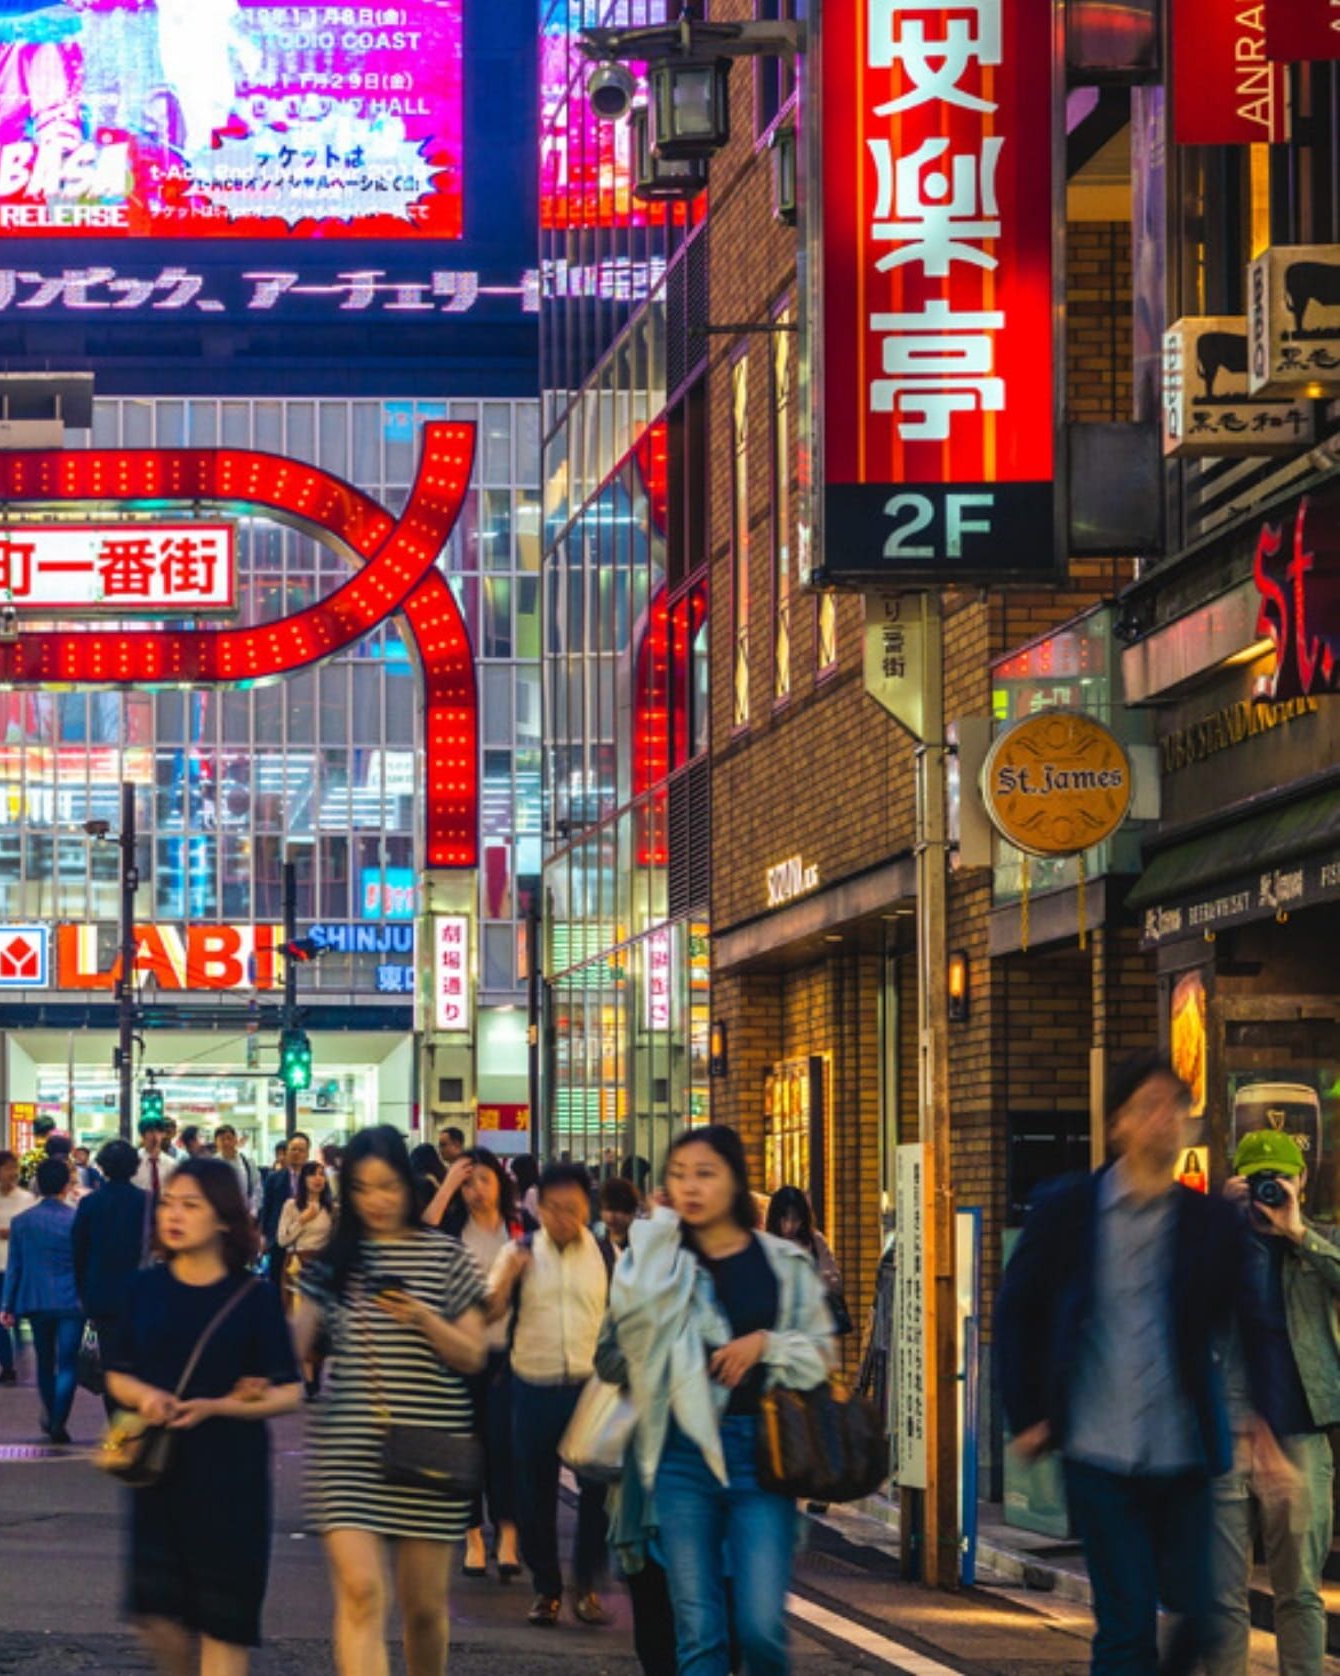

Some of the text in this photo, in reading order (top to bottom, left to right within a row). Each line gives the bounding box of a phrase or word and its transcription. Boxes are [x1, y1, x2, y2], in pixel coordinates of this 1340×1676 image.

[342, 32, 422, 49] COAST
[1235, 0, 1271, 128] ANRA
[866, 0, 1005, 440] 安楽亭
[882, 493, 994, 558] 2F
[58, 924, 283, 989] LABI
[441, 924, 461, 1021] 劇場通り
